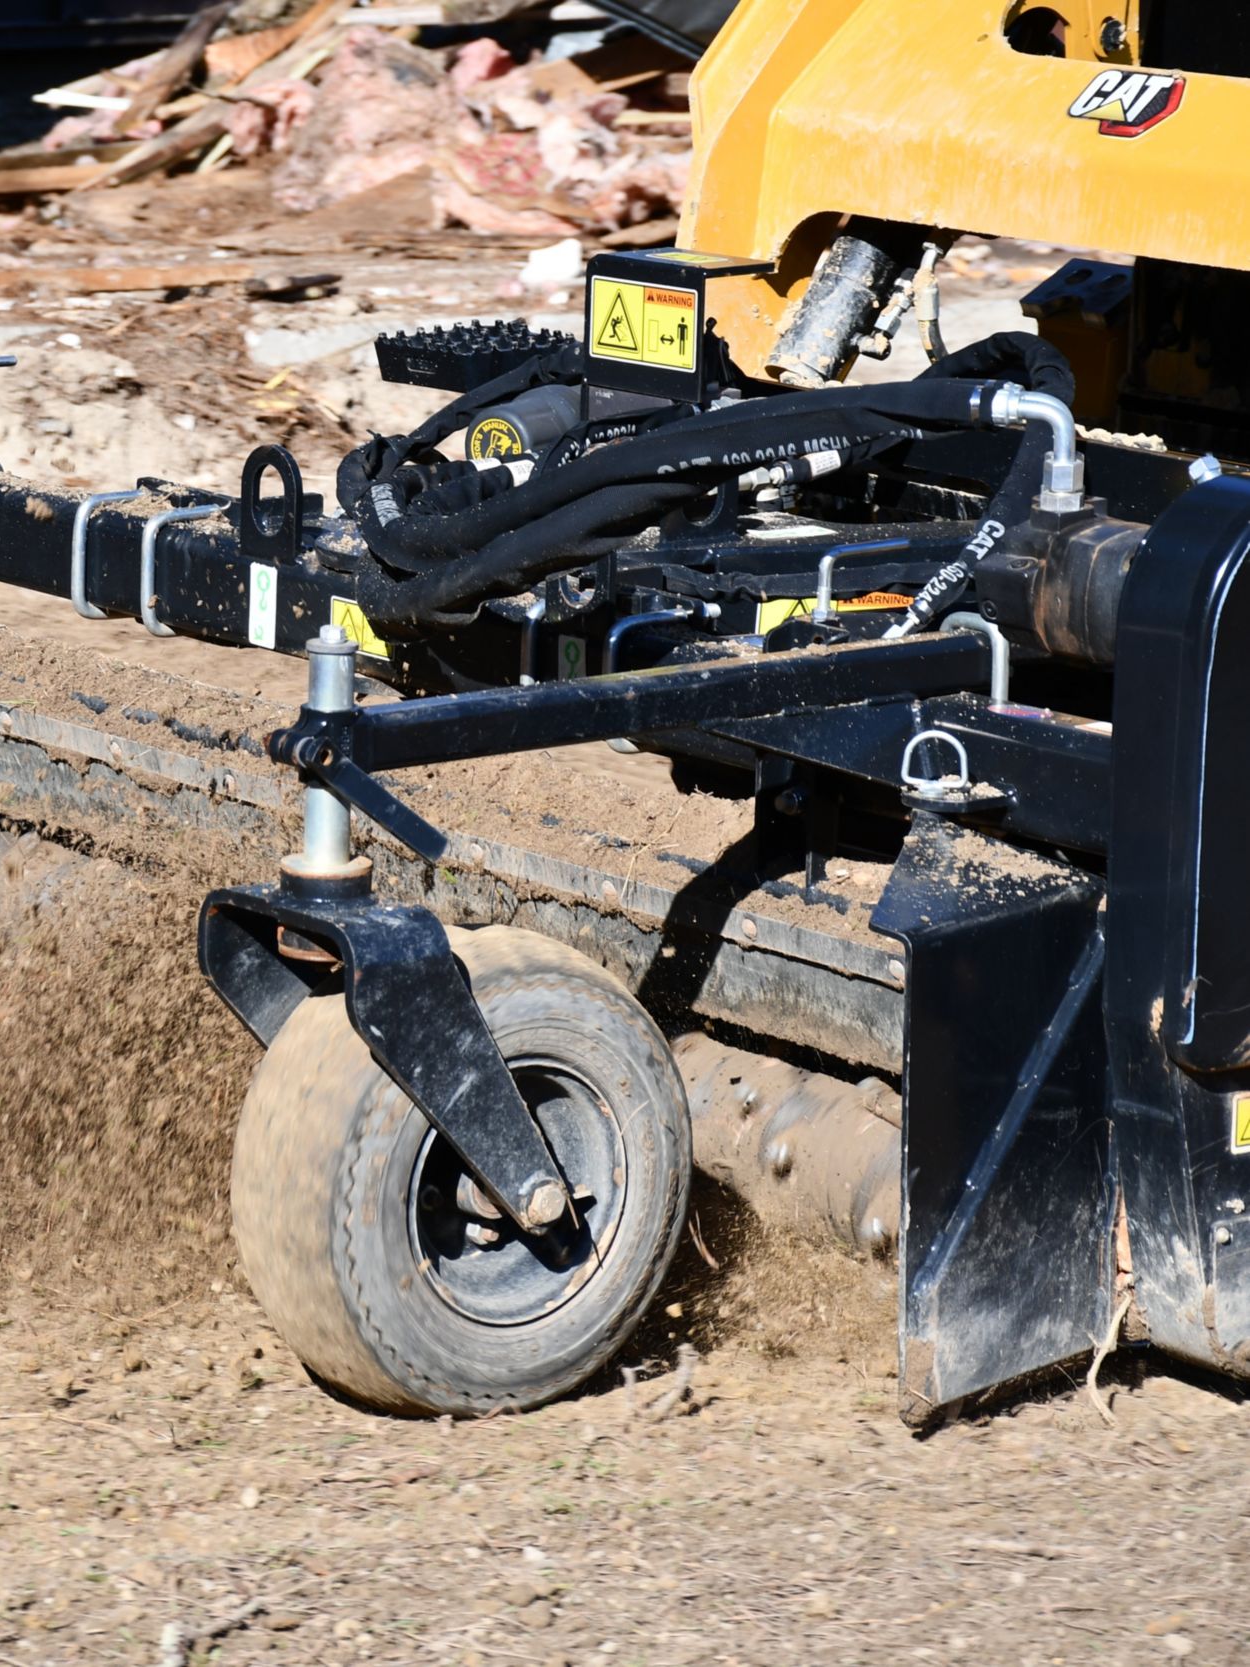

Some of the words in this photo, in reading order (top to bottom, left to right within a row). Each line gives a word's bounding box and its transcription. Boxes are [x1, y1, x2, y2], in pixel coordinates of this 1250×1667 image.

[1069, 69, 1175, 123] CAT
[655, 292, 693, 308] WARNING
[966, 519, 1006, 561] CAT
[858, 595, 910, 605] WARNING
[914, 561, 968, 603] 160-224
